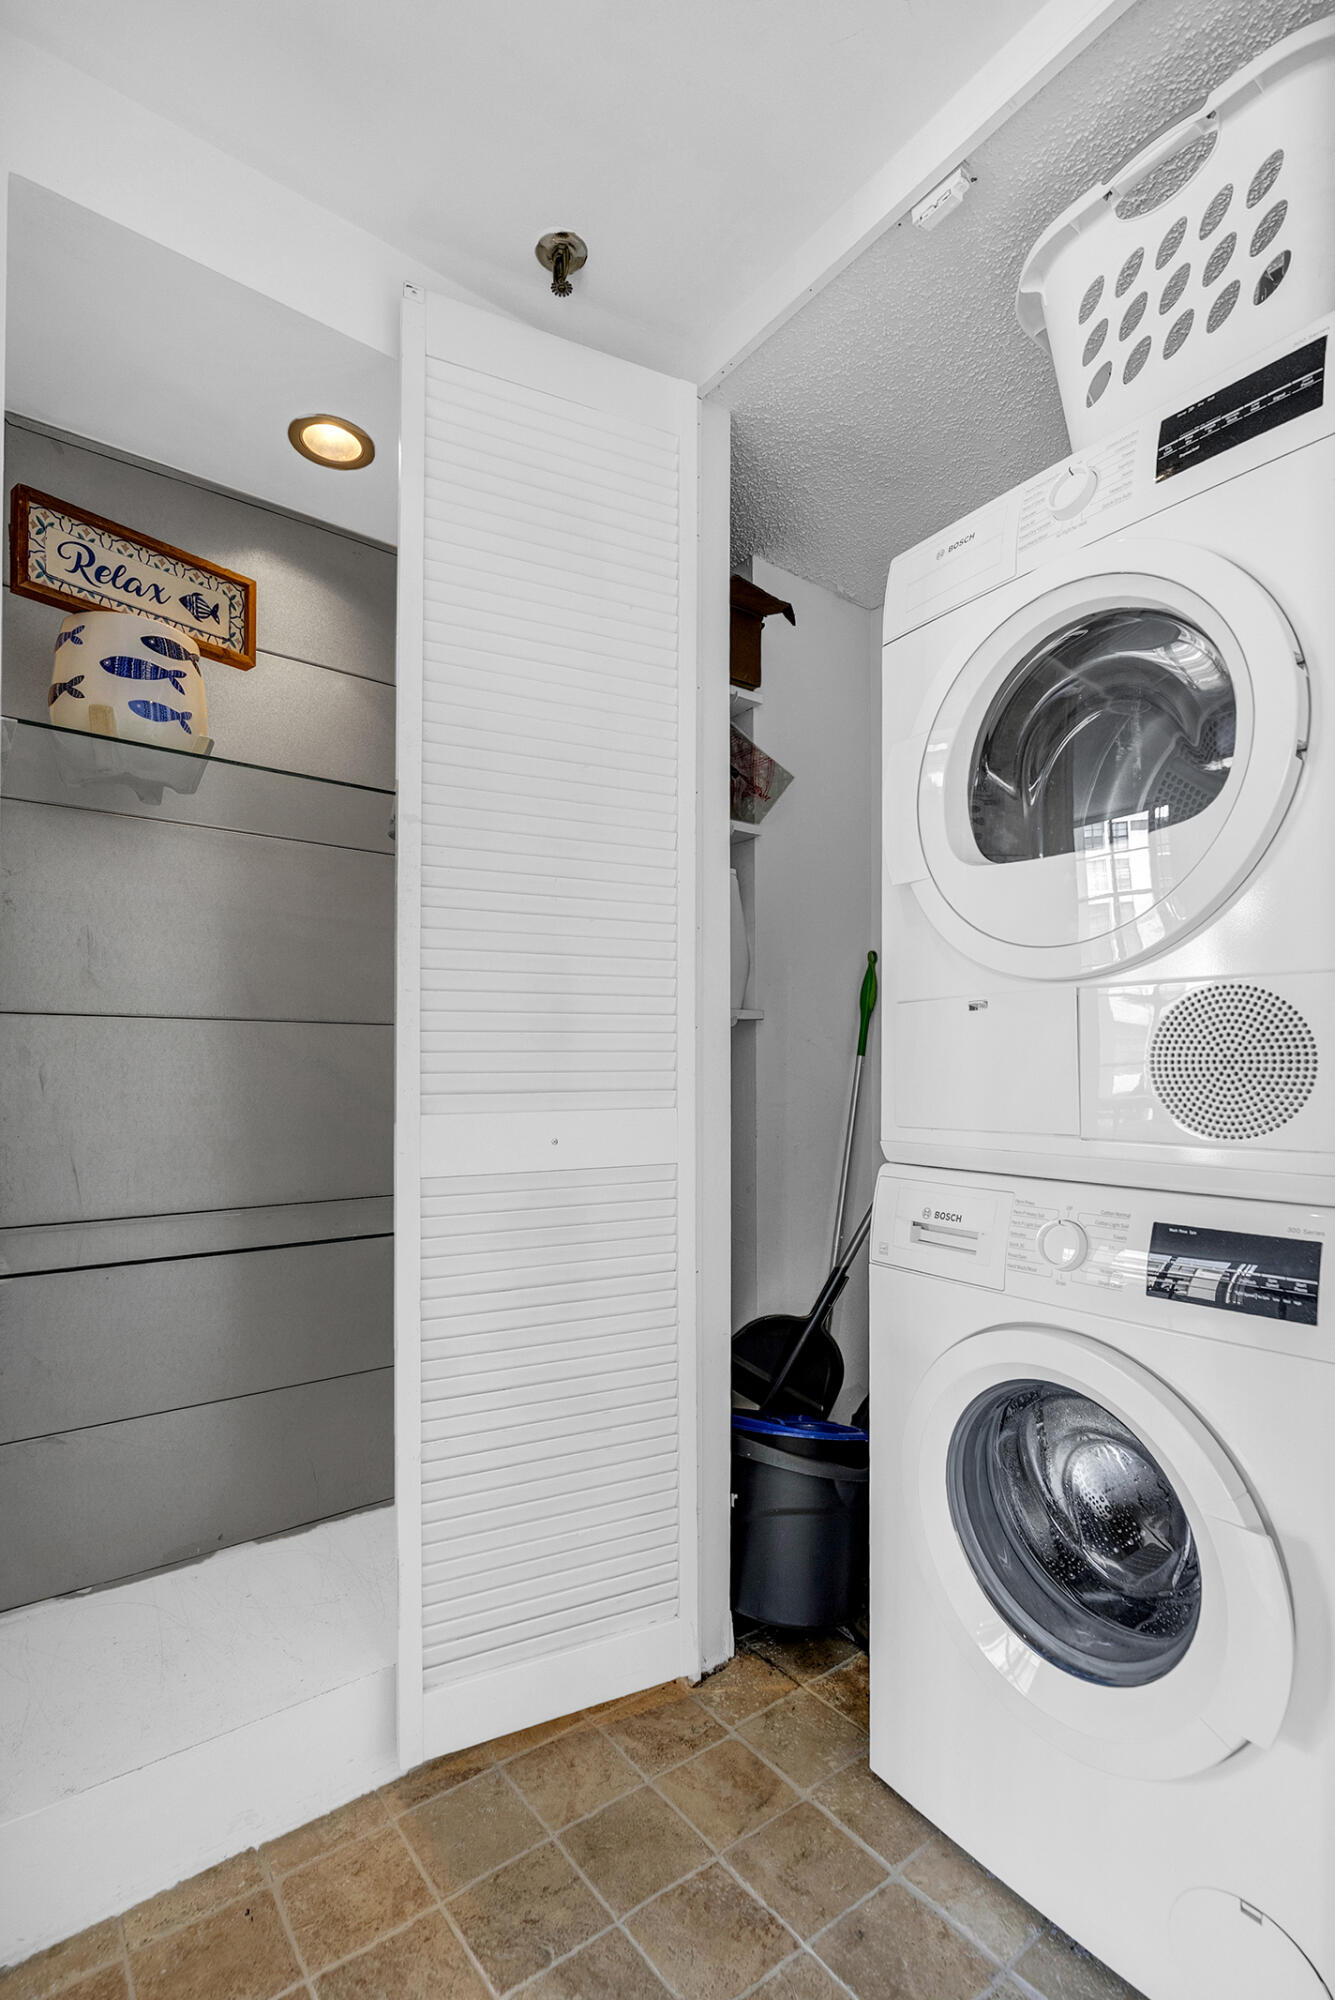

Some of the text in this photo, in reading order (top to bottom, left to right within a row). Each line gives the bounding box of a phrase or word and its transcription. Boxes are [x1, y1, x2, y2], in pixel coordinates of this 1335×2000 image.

[948, 532, 976, 552] BOSCH
[57, 541, 171, 604] Relax
[934, 1210, 963, 1223] BOSCH
